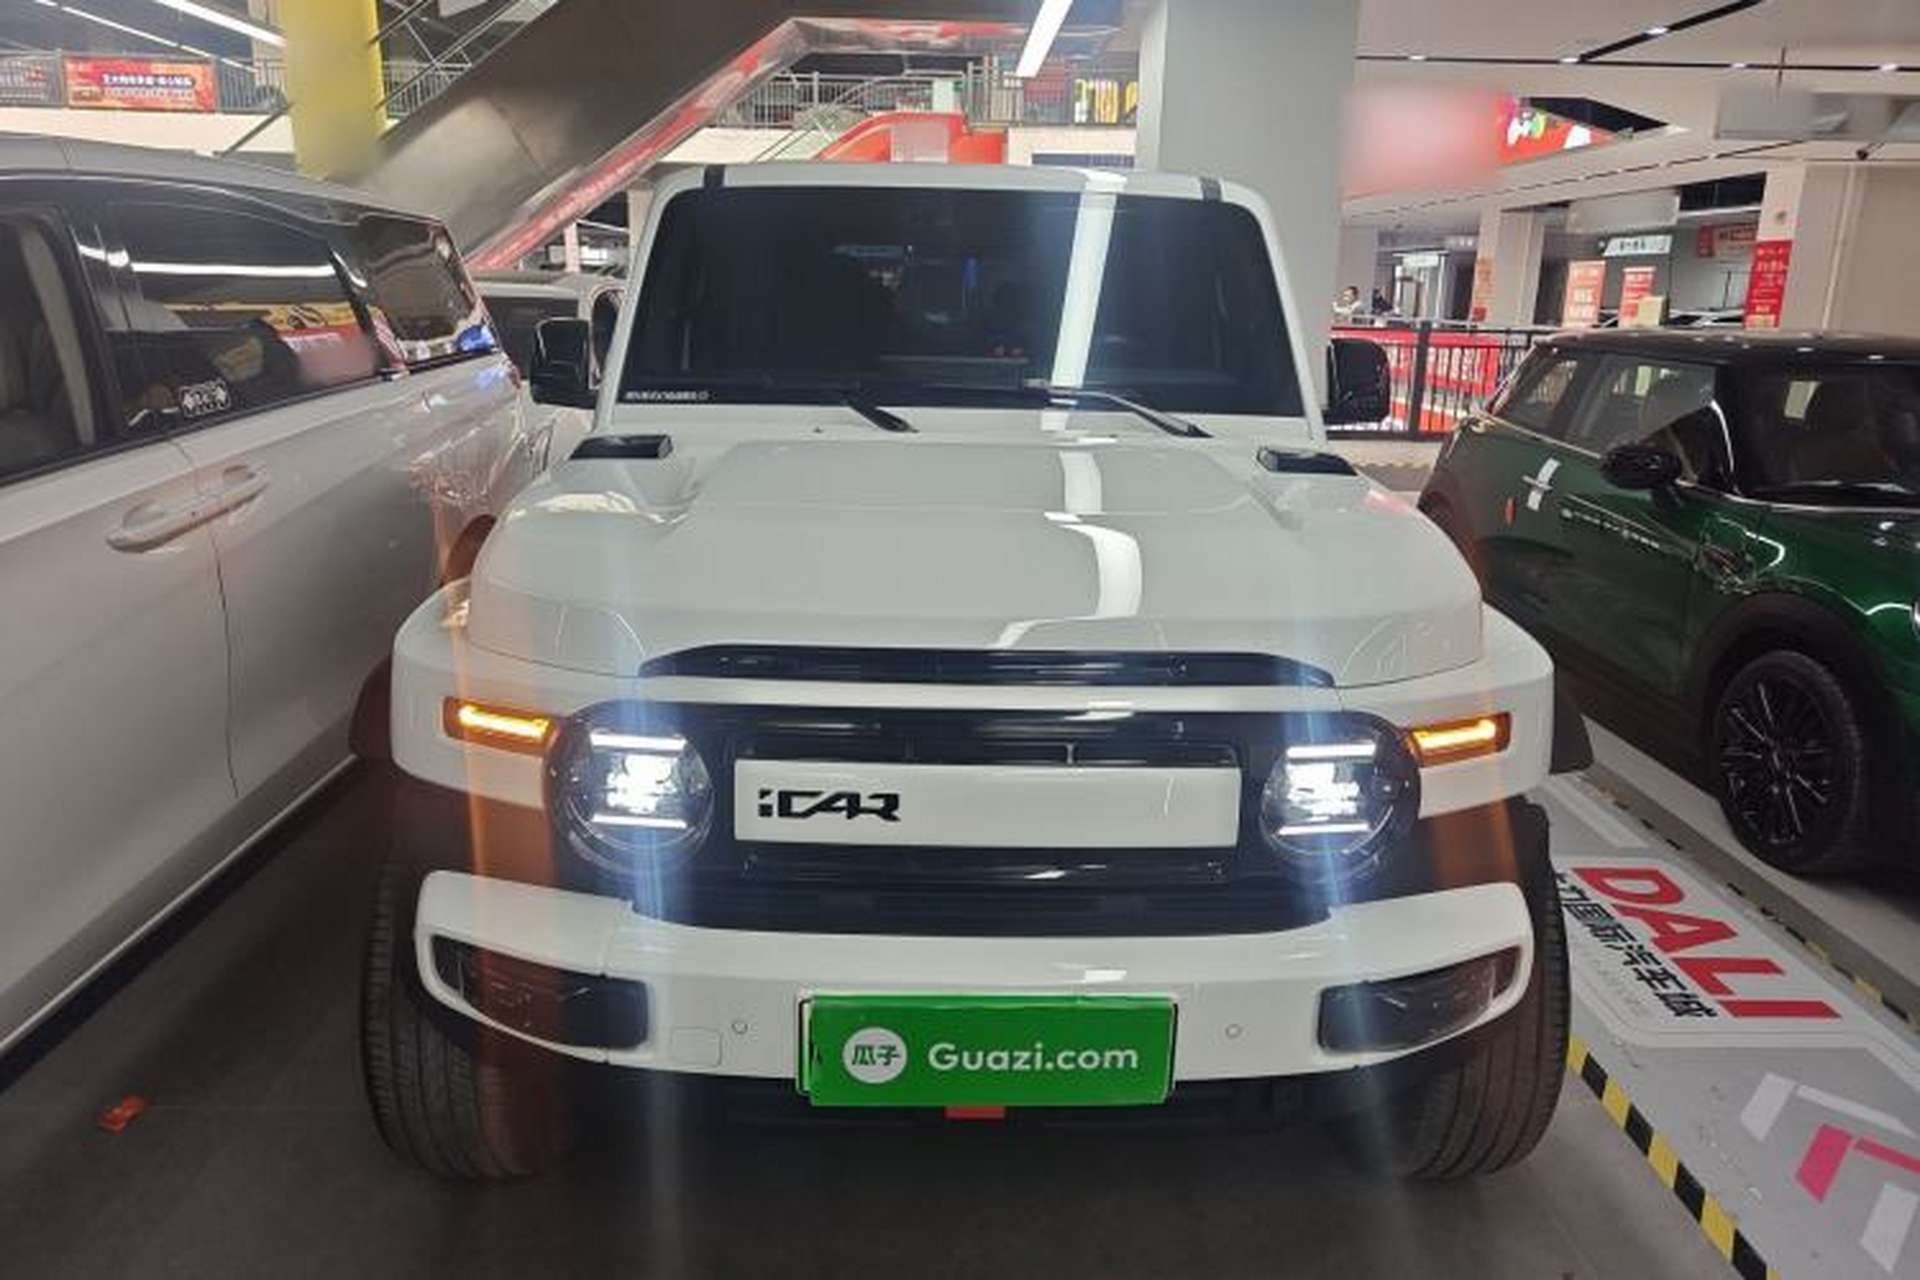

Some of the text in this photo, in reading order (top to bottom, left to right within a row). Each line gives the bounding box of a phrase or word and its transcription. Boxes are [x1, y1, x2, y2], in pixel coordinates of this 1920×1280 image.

[758, 789, 901, 821] iCAR
[1571, 868, 1842, 1018] DALI
[852, 1042, 1139, 1071] 瓜子 Guazi.com
